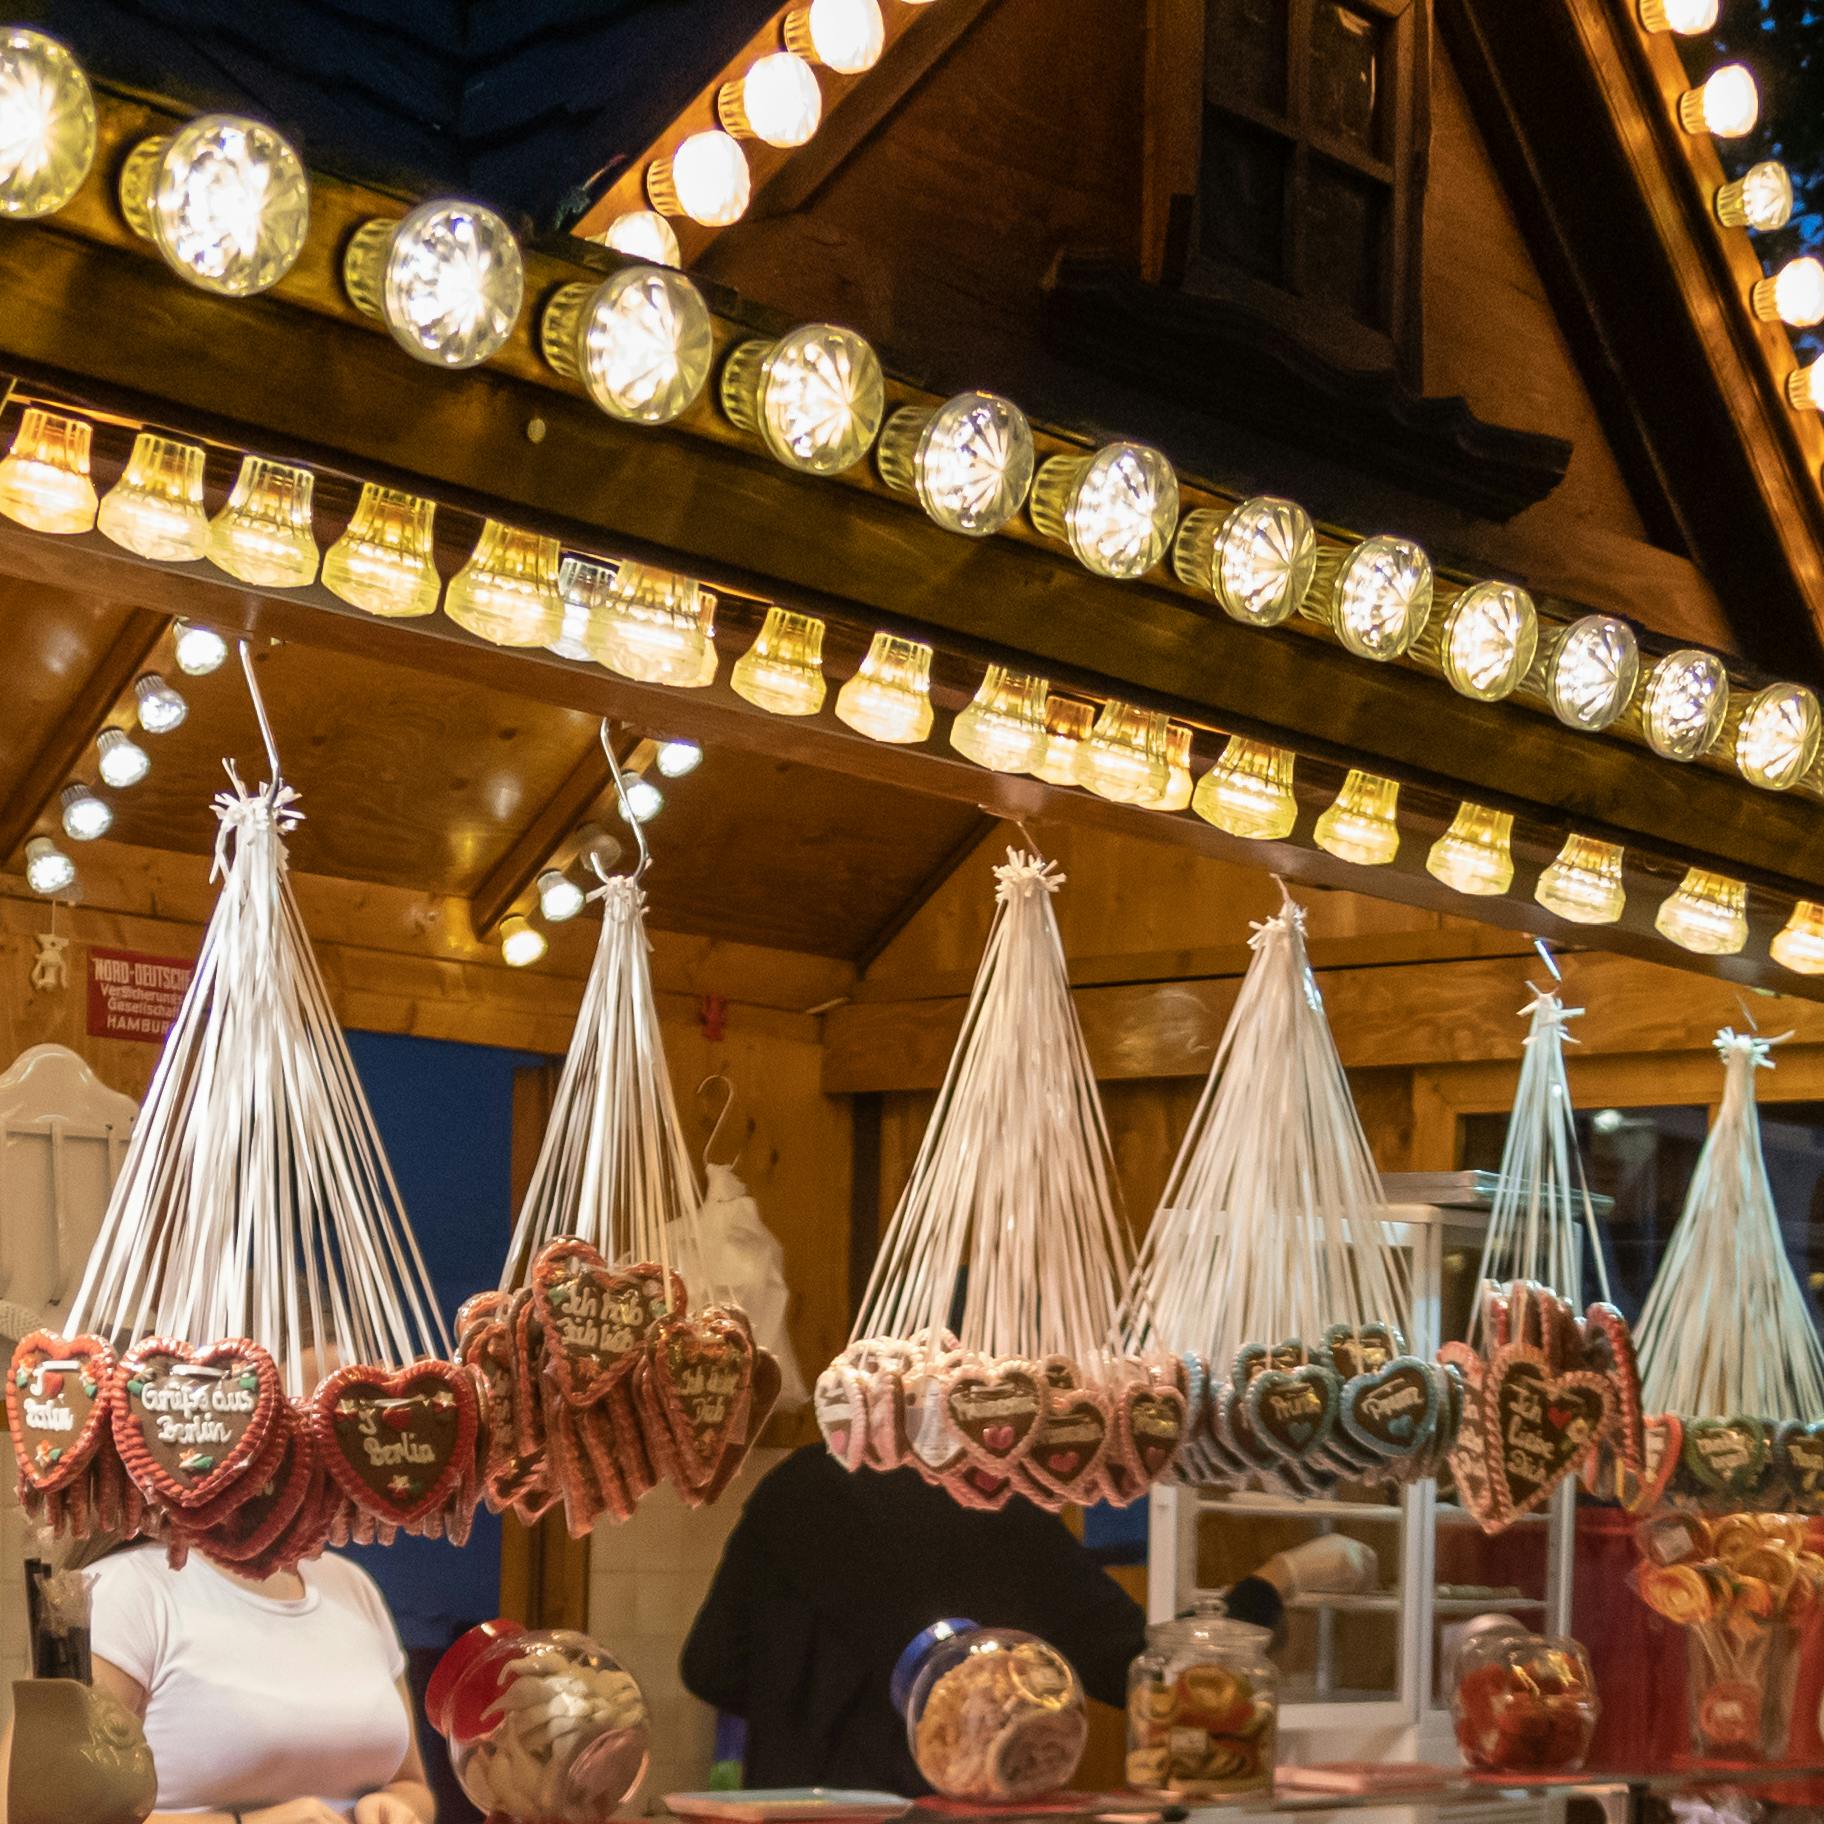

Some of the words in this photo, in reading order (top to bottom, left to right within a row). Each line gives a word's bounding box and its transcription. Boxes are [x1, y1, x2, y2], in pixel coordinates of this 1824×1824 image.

[107, 1015, 169, 1035] HAMBUR
[24, 1393, 74, 1431] Berlin
[212, 1382, 256, 1412] aus
[156, 1412, 233, 1444] Berlin
[363, 1432, 435, 1466] Berlin
